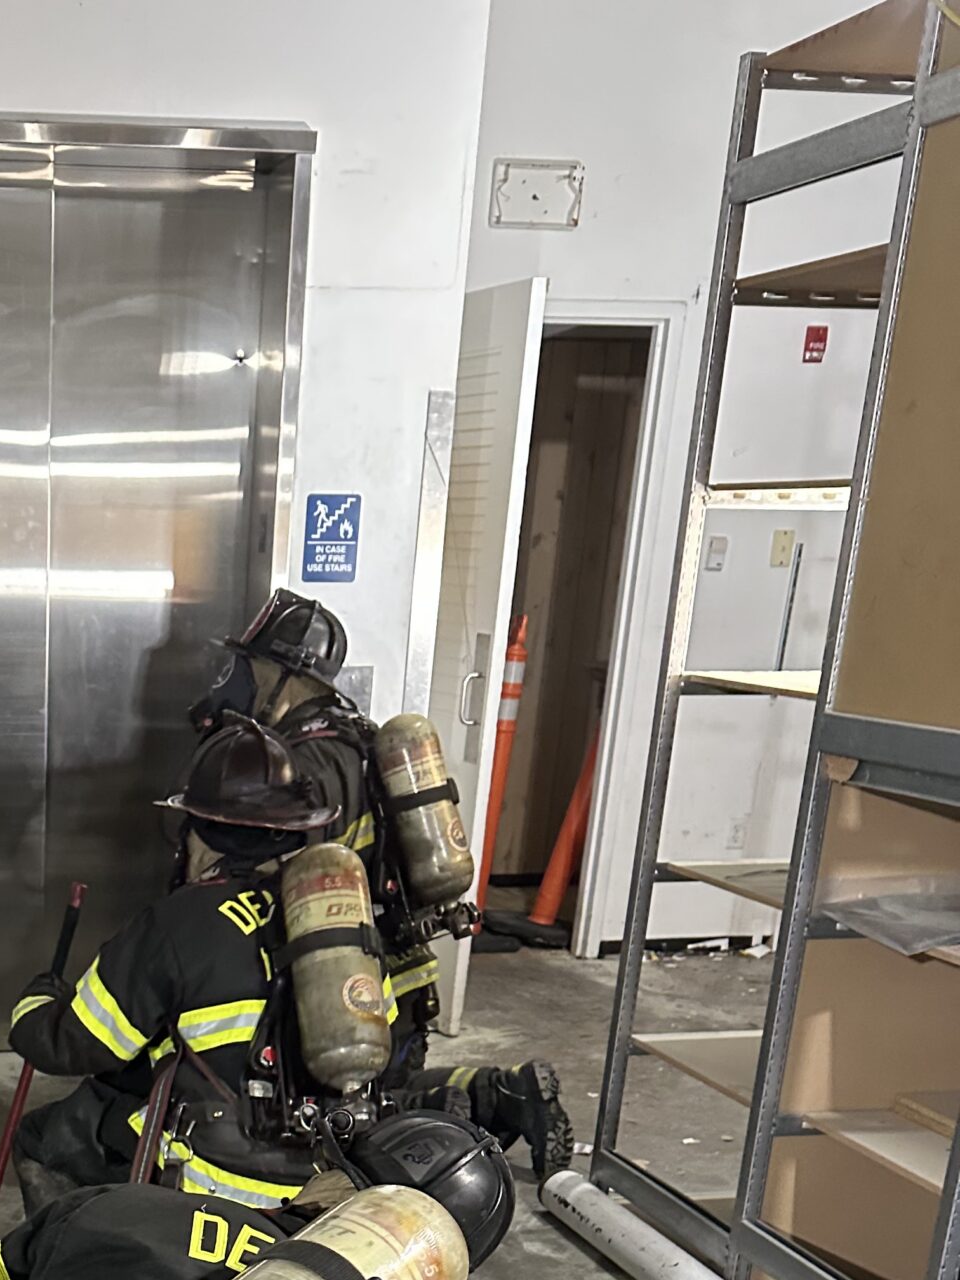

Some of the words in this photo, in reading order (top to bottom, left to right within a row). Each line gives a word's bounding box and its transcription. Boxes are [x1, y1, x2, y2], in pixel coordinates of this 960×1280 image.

[315, 545, 324, 553] IN
[325, 545, 346, 553] CASE
[315, 554, 326, 562] OF
[328, 554, 345, 562] FIRE
[307, 563, 323, 572] USE
[324, 563, 352, 572] STAIRS
[218, 890, 275, 935] DE
